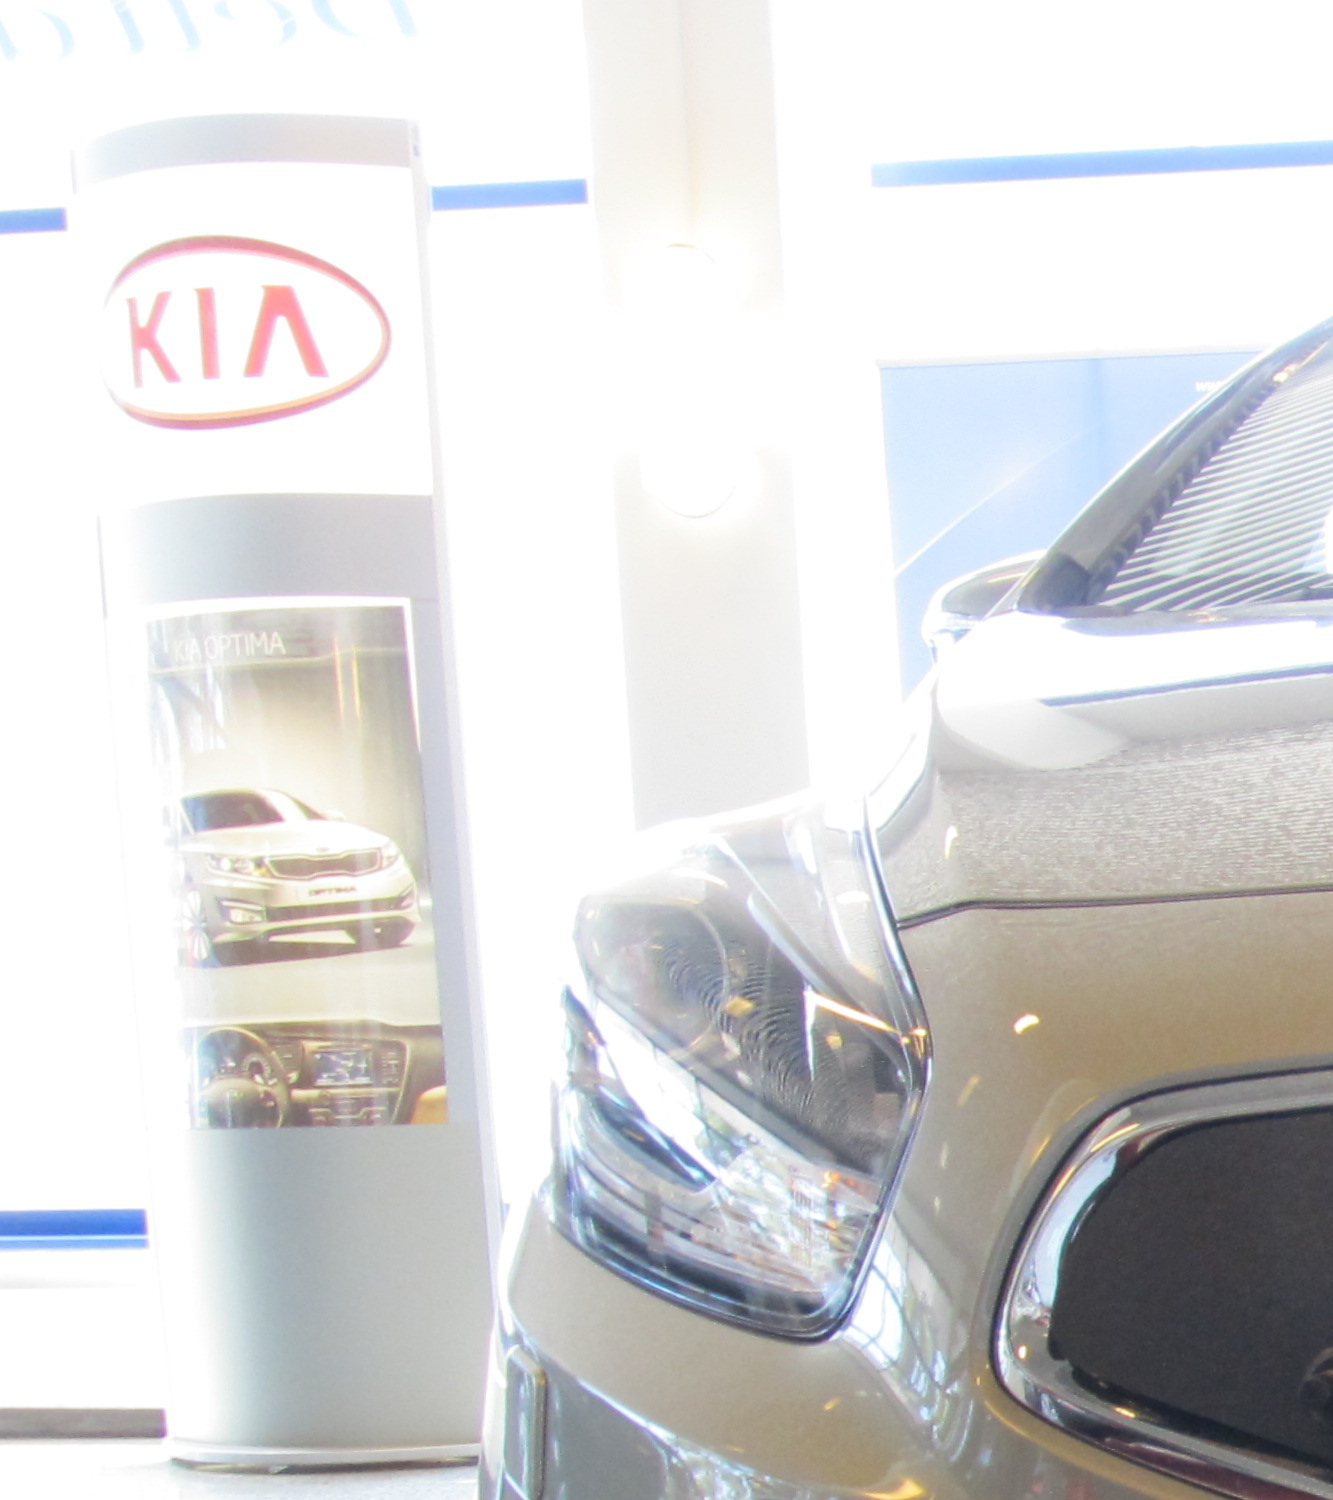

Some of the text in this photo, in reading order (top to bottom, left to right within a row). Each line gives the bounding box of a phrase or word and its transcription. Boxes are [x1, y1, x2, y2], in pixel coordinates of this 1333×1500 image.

[126, 285, 329, 388] KIA
[174, 631, 287, 664] KIA OPTIMA
